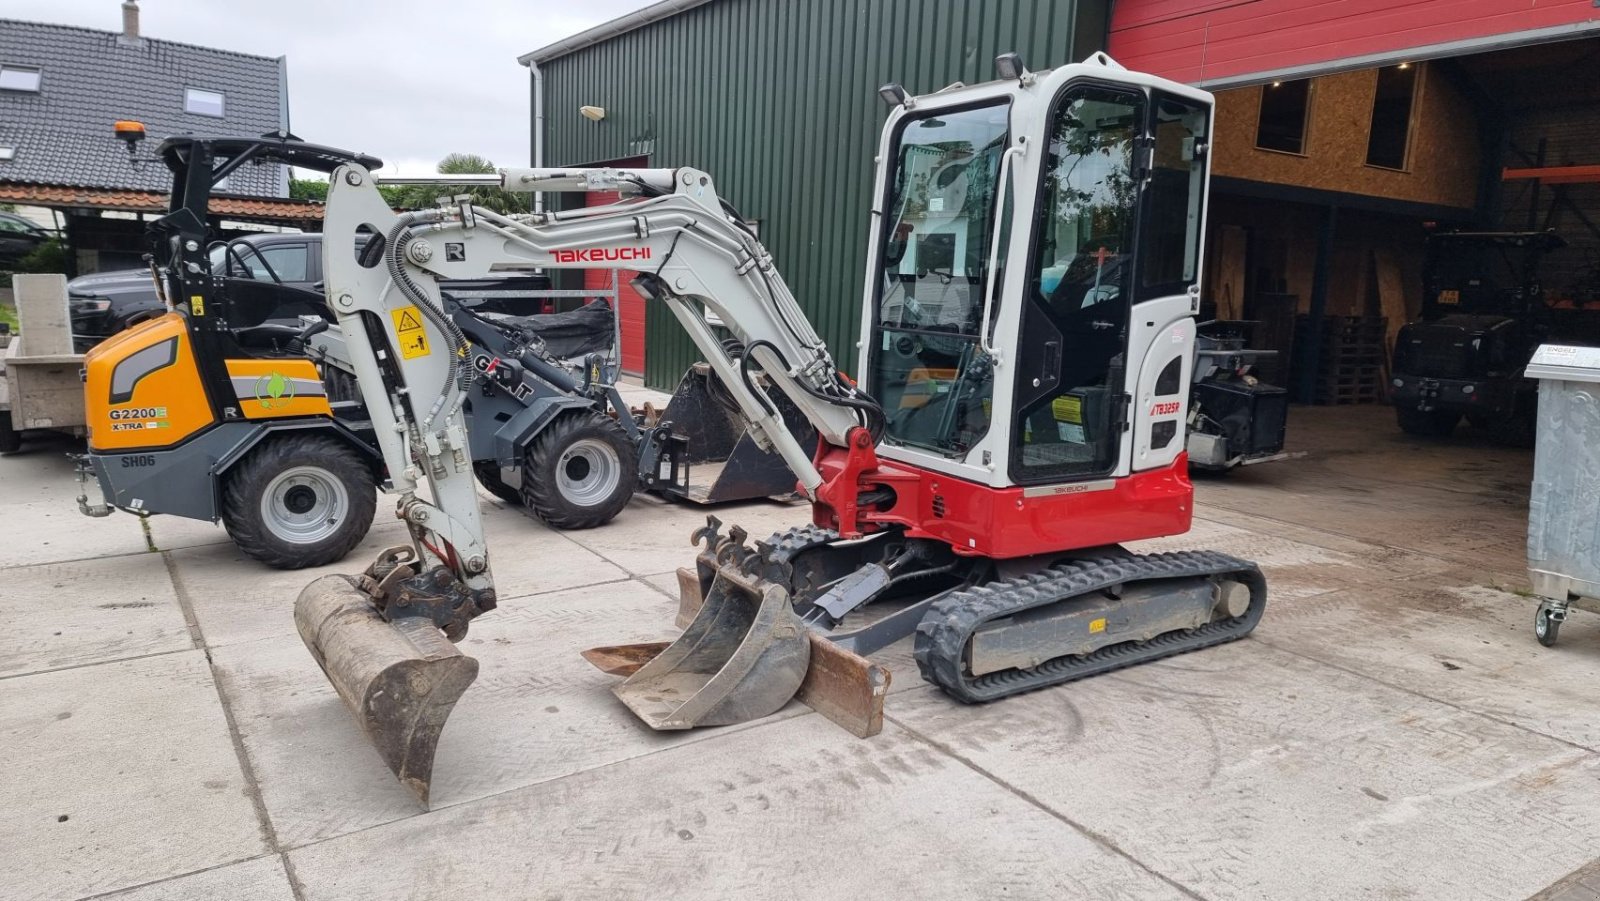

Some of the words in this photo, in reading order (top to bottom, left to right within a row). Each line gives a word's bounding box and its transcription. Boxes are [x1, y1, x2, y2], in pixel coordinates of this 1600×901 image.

[549, 247, 651, 263] TAKEUCHI
[112, 422, 144, 431] X-TRA
[121, 455, 156, 468] SH06
[1053, 484, 1089, 494] TAKEUCHI
